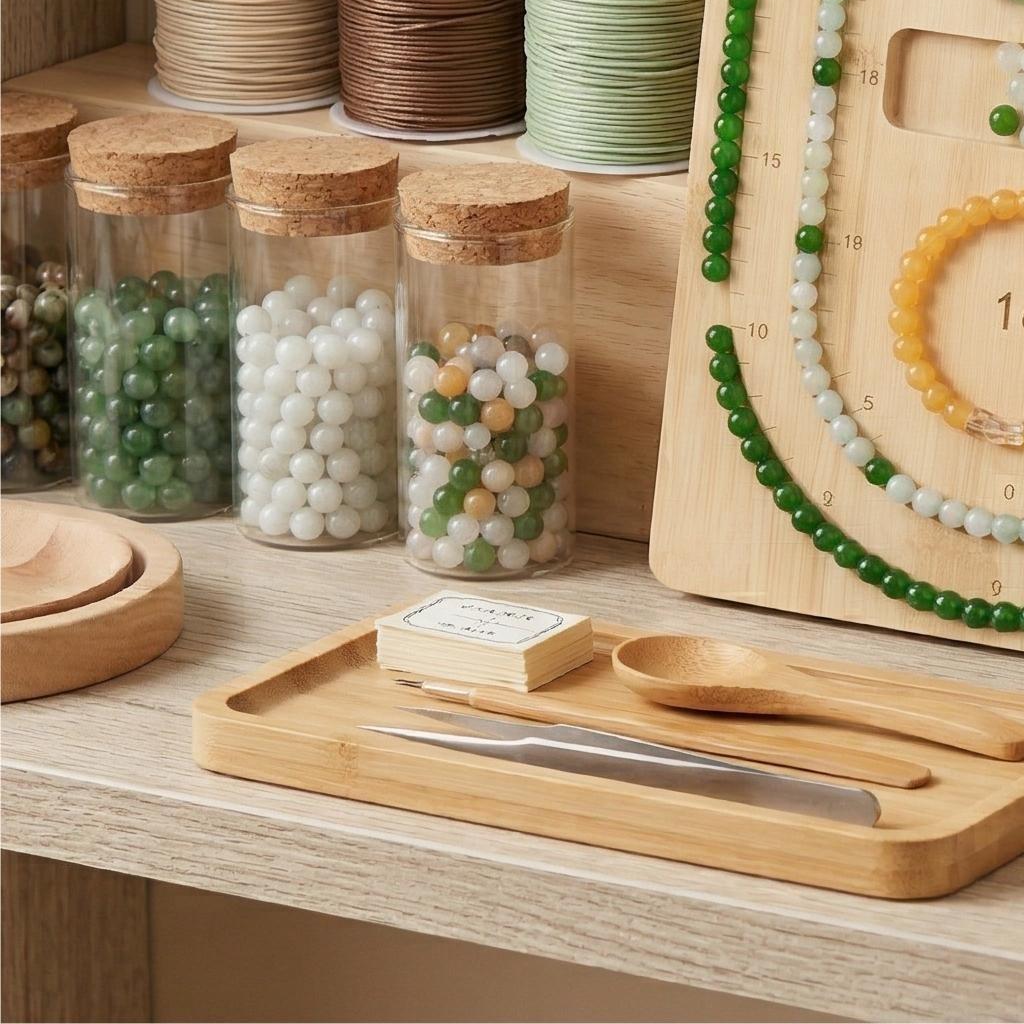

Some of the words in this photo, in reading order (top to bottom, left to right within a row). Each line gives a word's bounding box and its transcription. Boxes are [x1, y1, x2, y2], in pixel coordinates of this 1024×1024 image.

[860, 69, 879, 86] 18
[762, 153, 781, 169] 15
[748, 322, 769, 339] 10
[863, 395, 875, 411] 5
